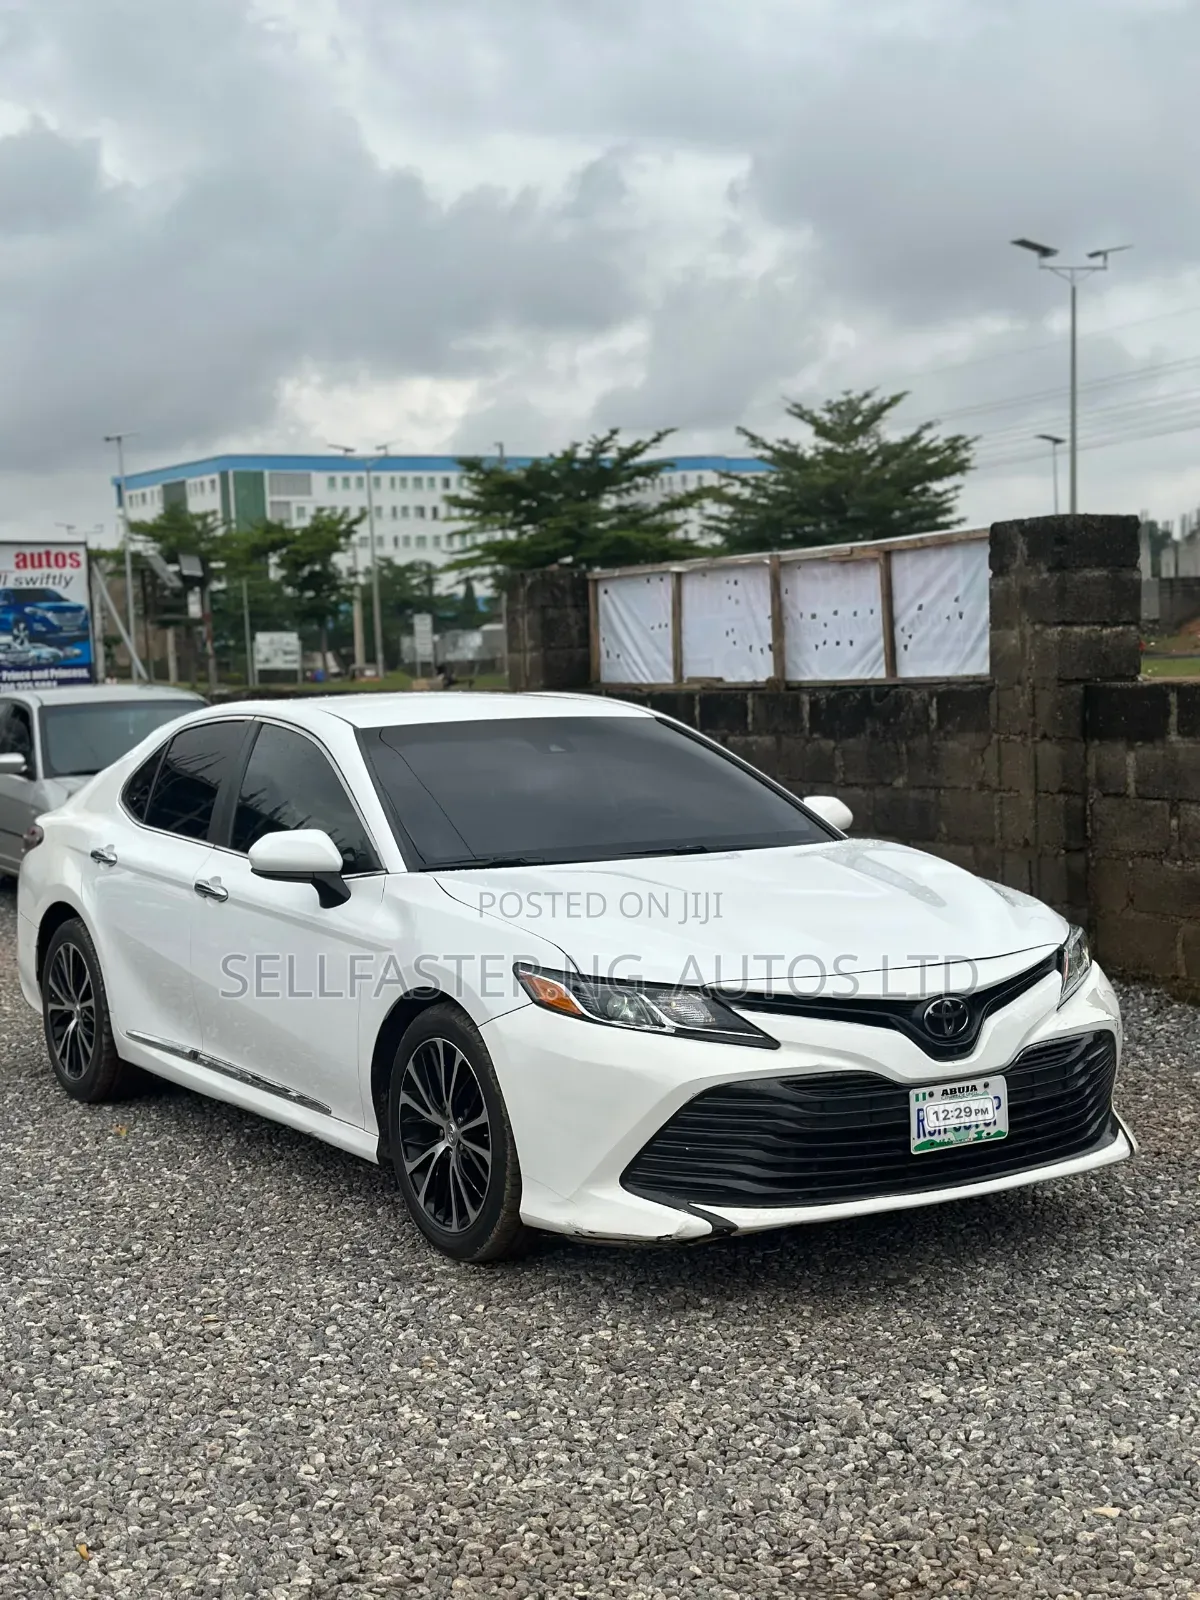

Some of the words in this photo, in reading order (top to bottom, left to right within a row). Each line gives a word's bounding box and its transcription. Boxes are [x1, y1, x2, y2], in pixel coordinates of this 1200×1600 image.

[15, 550, 81, 569] autos
[14, 573, 74, 589] swiftly
[941, 1084, 978, 1097] ABUJA
